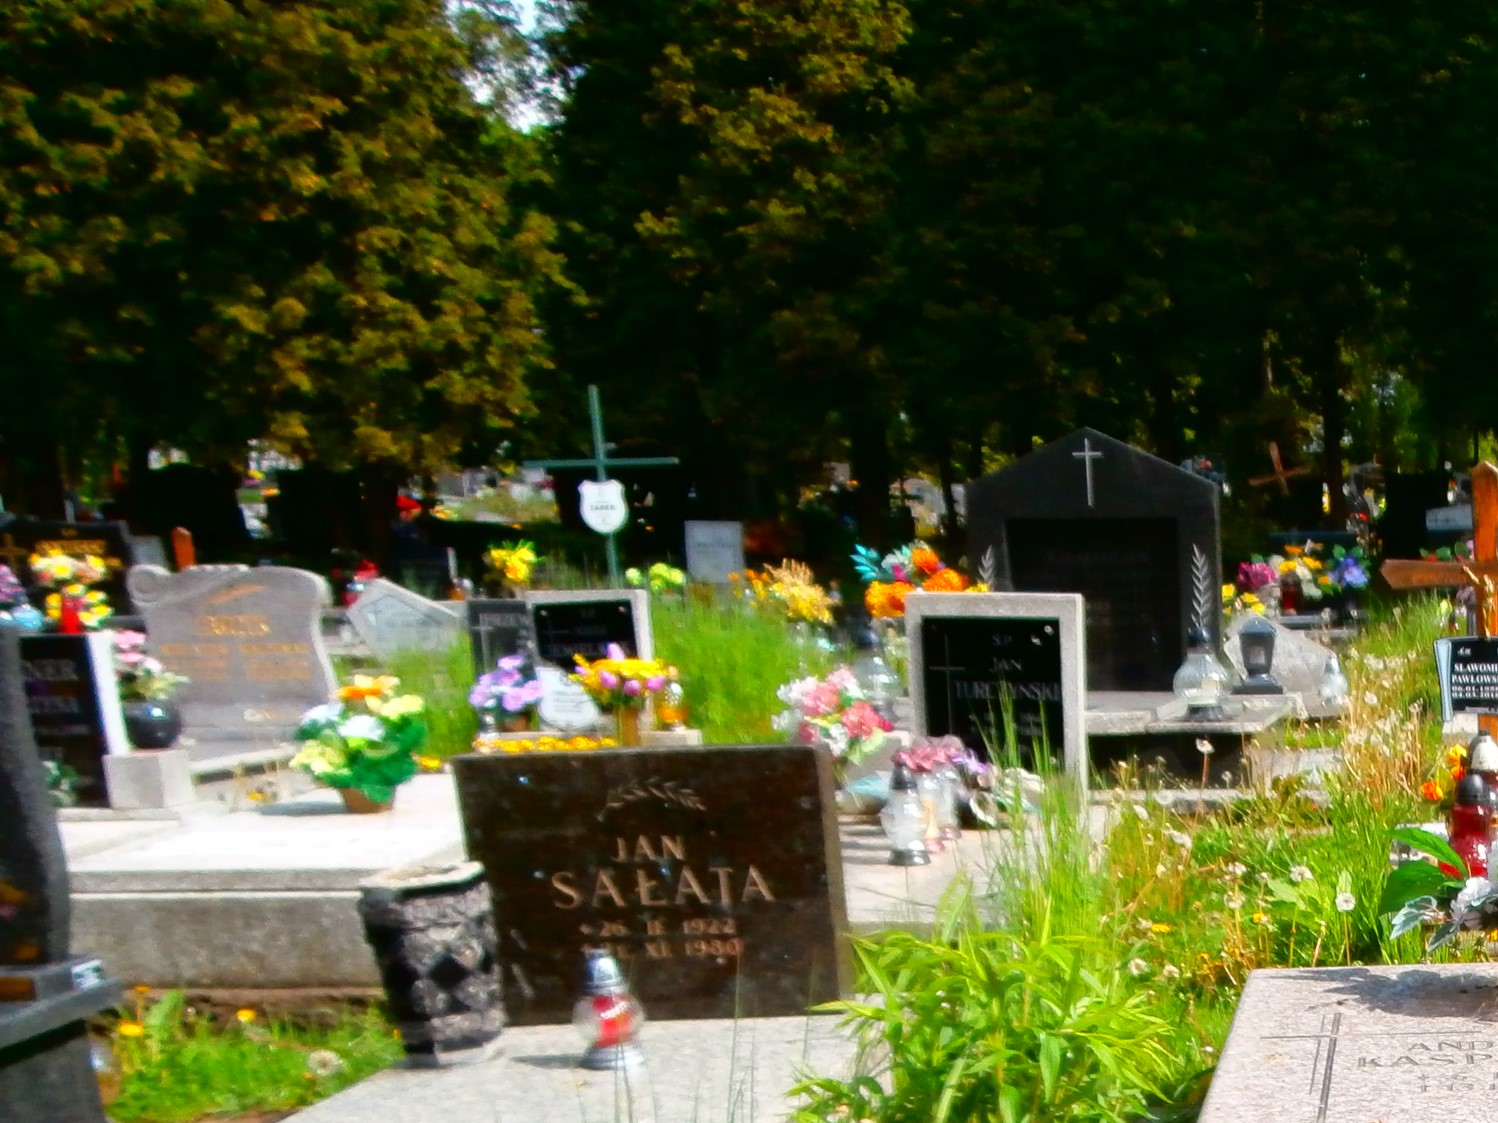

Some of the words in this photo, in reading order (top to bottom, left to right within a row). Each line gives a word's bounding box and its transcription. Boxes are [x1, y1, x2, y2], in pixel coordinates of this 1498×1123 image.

[988, 656, 1023, 673] JAN
[615, 834, 686, 863] JAN
[551, 864, 777, 909] SAŁATA
